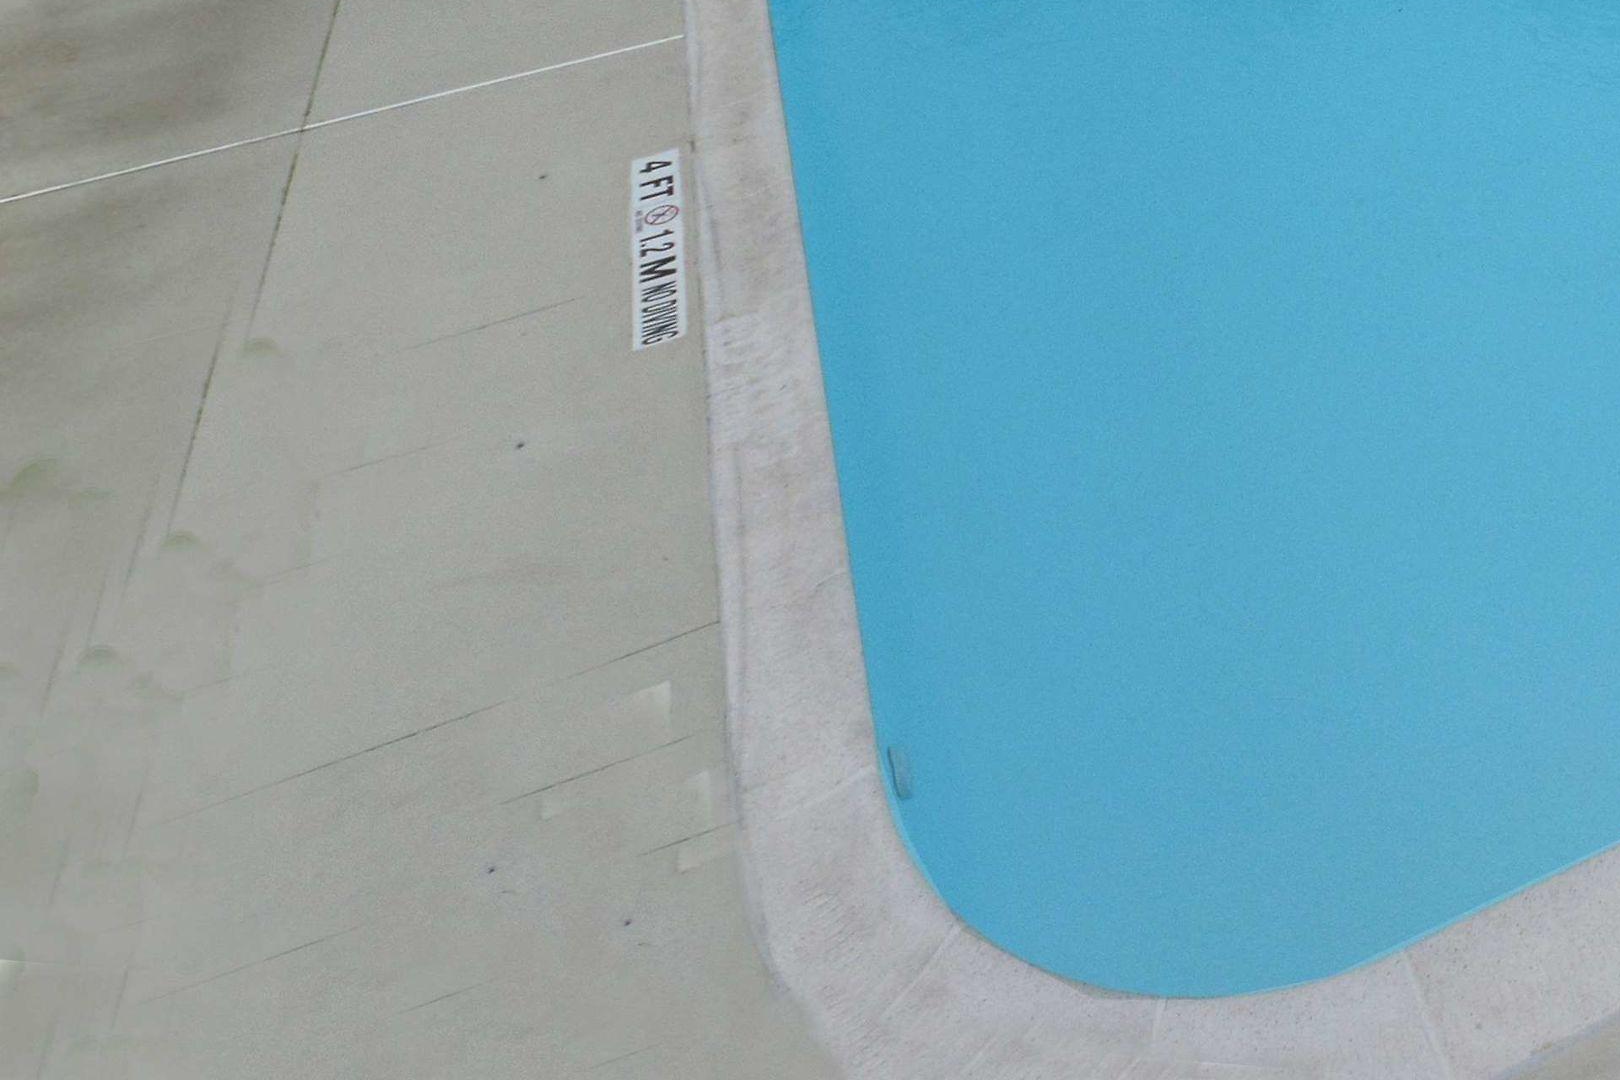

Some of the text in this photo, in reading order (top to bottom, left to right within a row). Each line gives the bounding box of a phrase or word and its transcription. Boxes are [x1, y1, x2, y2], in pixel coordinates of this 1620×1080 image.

[639, 160, 679, 346] 4 FT 1.2 M NO DIVING
